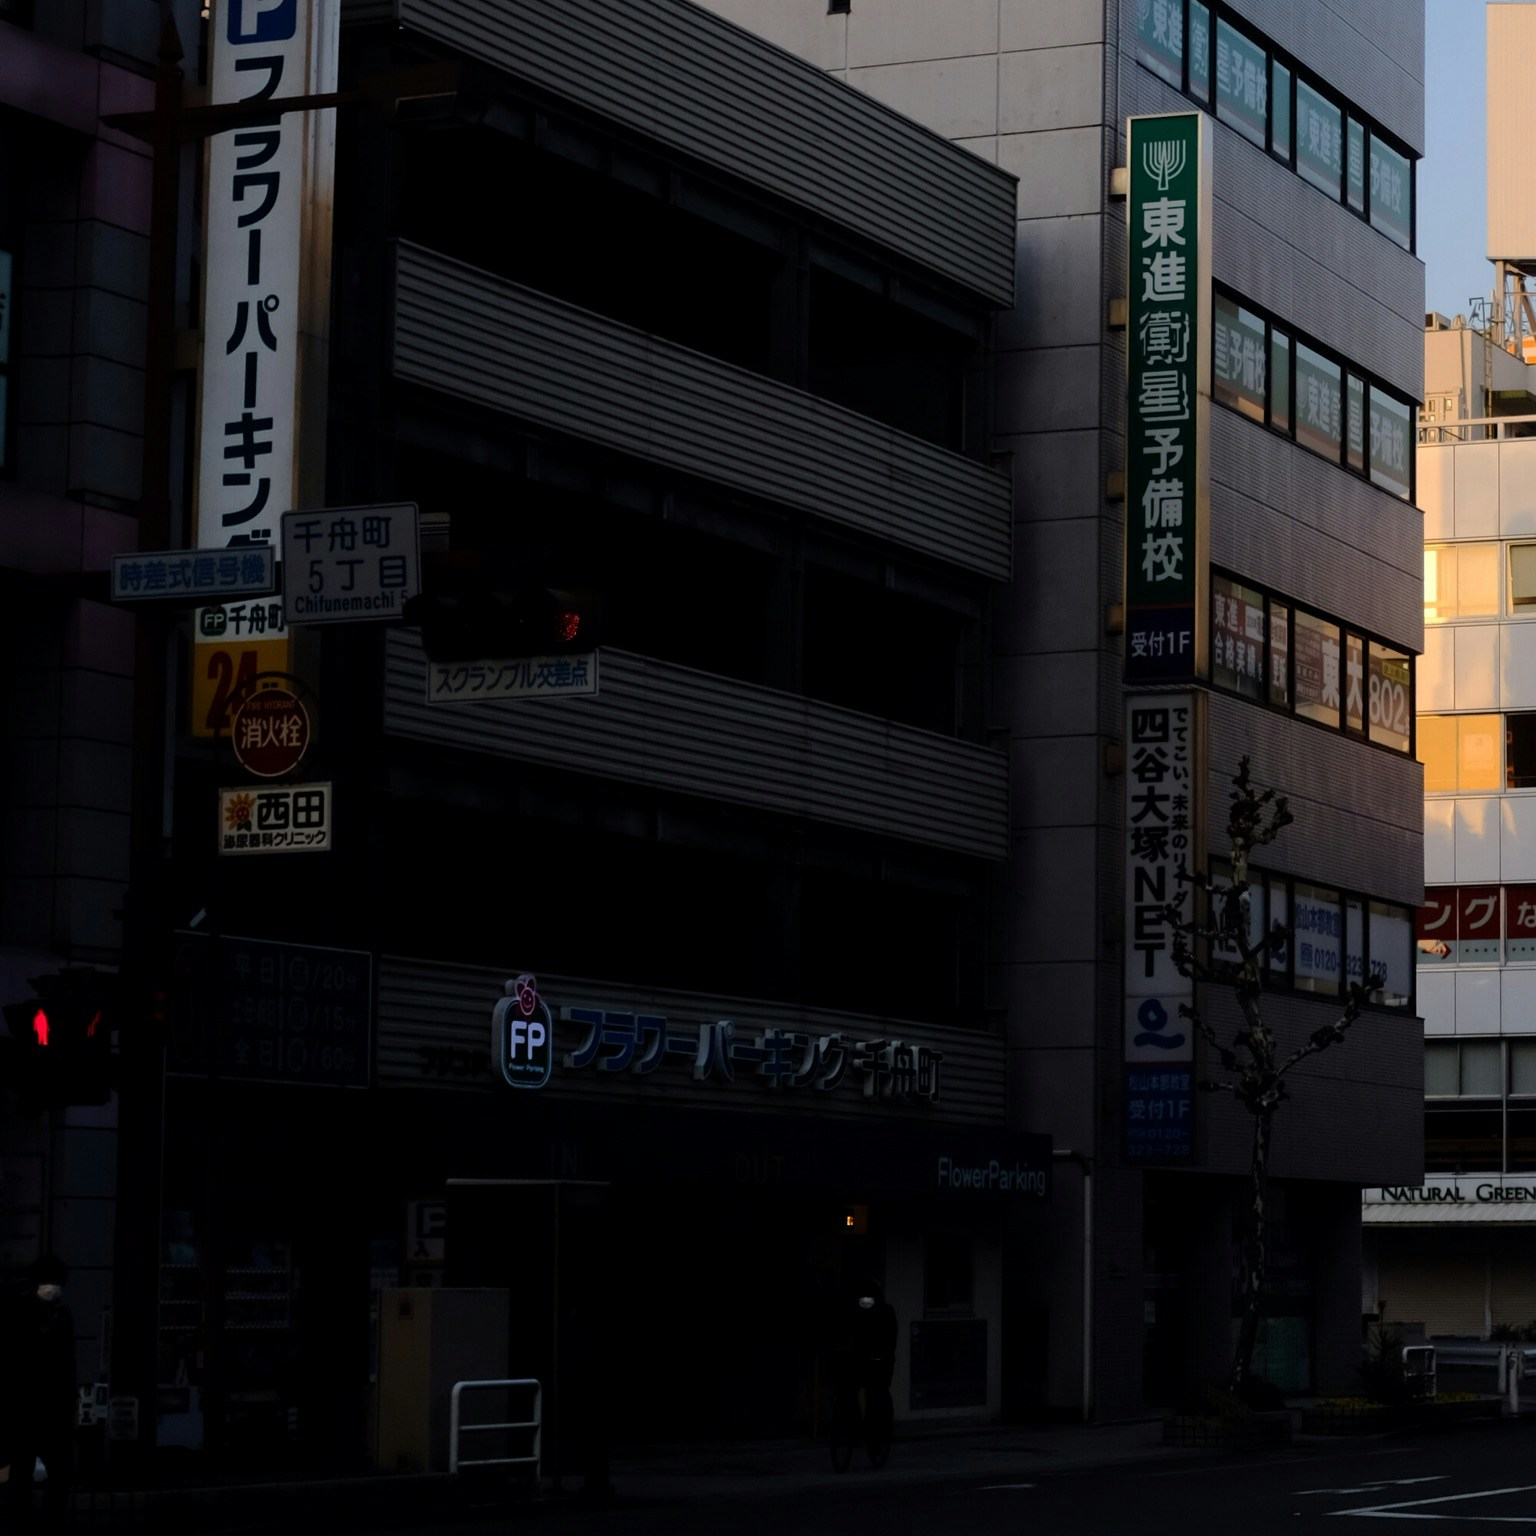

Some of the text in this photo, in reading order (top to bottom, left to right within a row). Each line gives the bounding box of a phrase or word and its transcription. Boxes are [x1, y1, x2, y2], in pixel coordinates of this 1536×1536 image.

[1138, 196, 1191, 582] 東進衛星予備校
[294, 516, 392, 552] 千舟町
[120, 555, 265, 591] 時差式信号機
[229, 604, 284, 635] 千舟町
[295, 591, 395, 614] Chifunemachi
[1131, 630, 1191, 659] 受付1F
[437, 660, 589, 693] スクランブル交差点
[241, 714, 303, 750] 消火栓
[257, 790, 324, 830] 西田
[224, 831, 326, 850] 泌尿器科クリニック
[1131, 707, 1169, 977] 四谷大塚NET
[511, 1019, 546, 1060] FP
[1129, 1098, 1191, 1120] 受付1F
[1381, 1185, 1465, 1202] NATURAL
